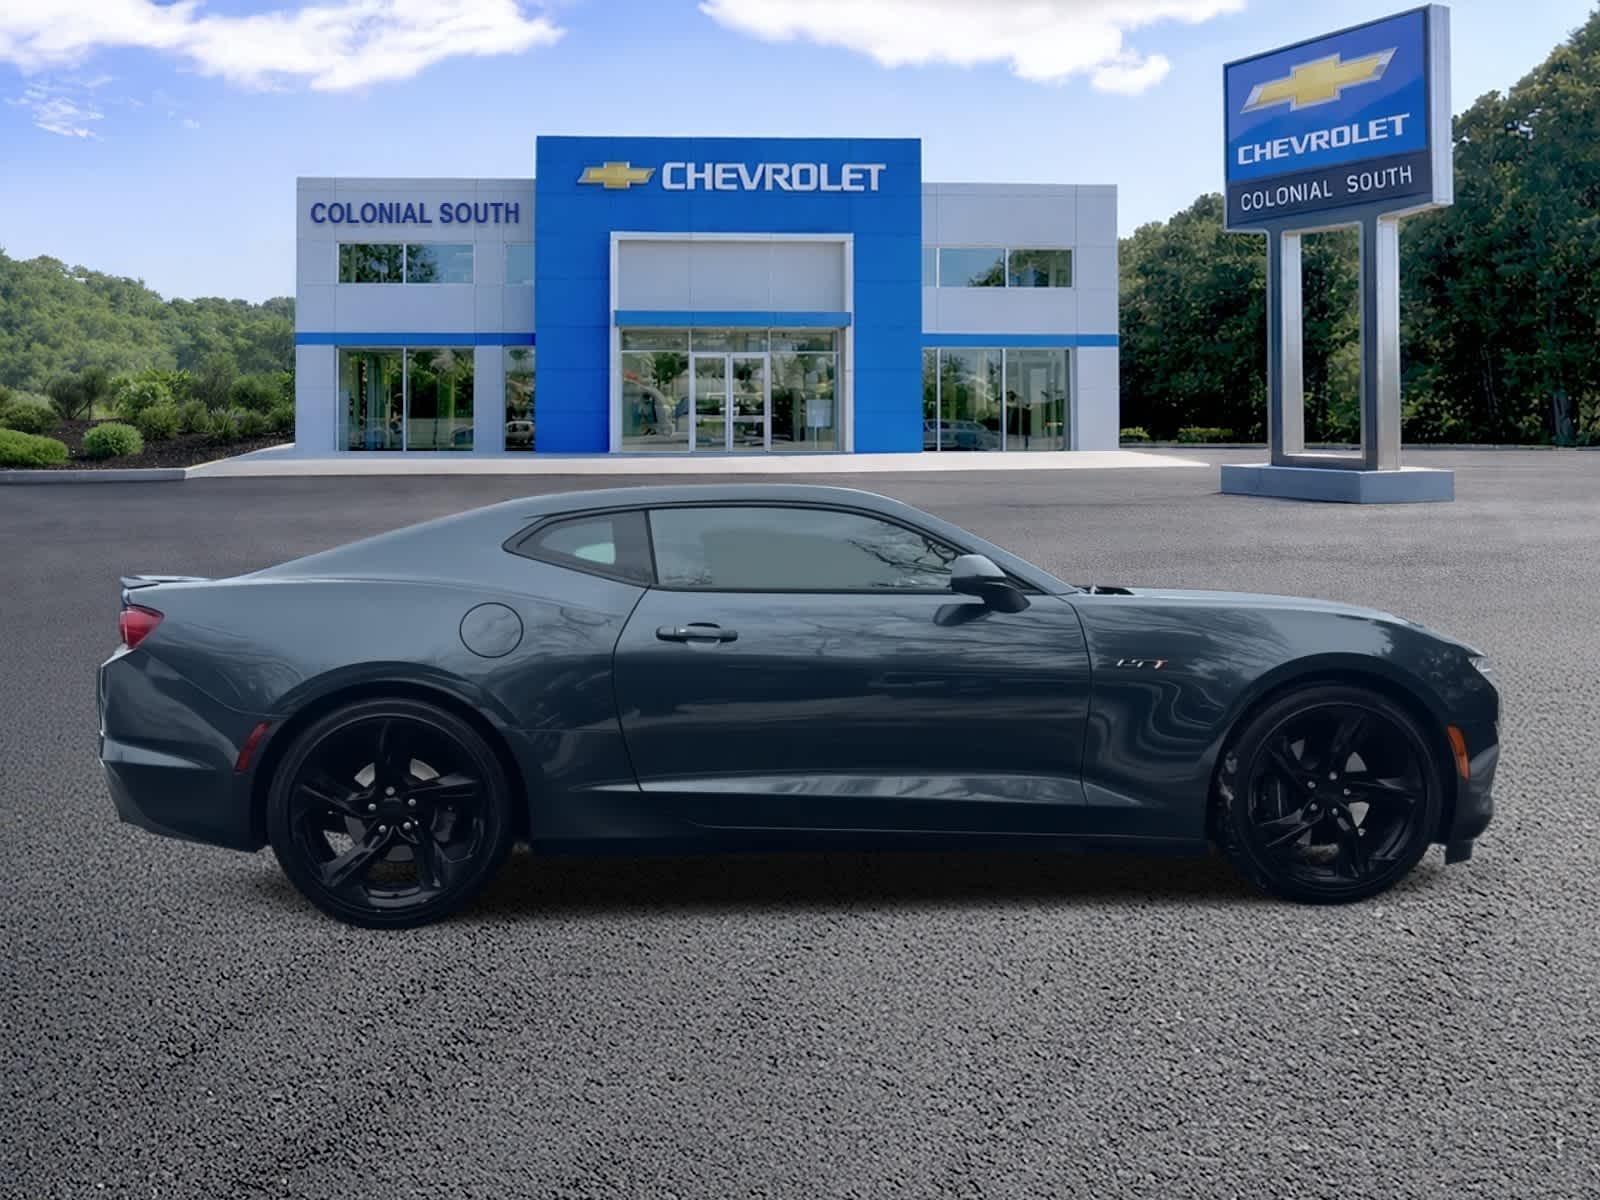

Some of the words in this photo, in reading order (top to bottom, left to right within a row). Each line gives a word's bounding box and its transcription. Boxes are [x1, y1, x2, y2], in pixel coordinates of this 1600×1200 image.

[1237, 113, 1410, 165] CHEVROLET
[662, 162, 887, 192] CHEVROLET
[1241, 180, 1333, 211] COLONIAL
[1347, 165, 1412, 193] SOUTH
[310, 202, 432, 224] COLONIAL
[440, 202, 519, 224] SOUTH
